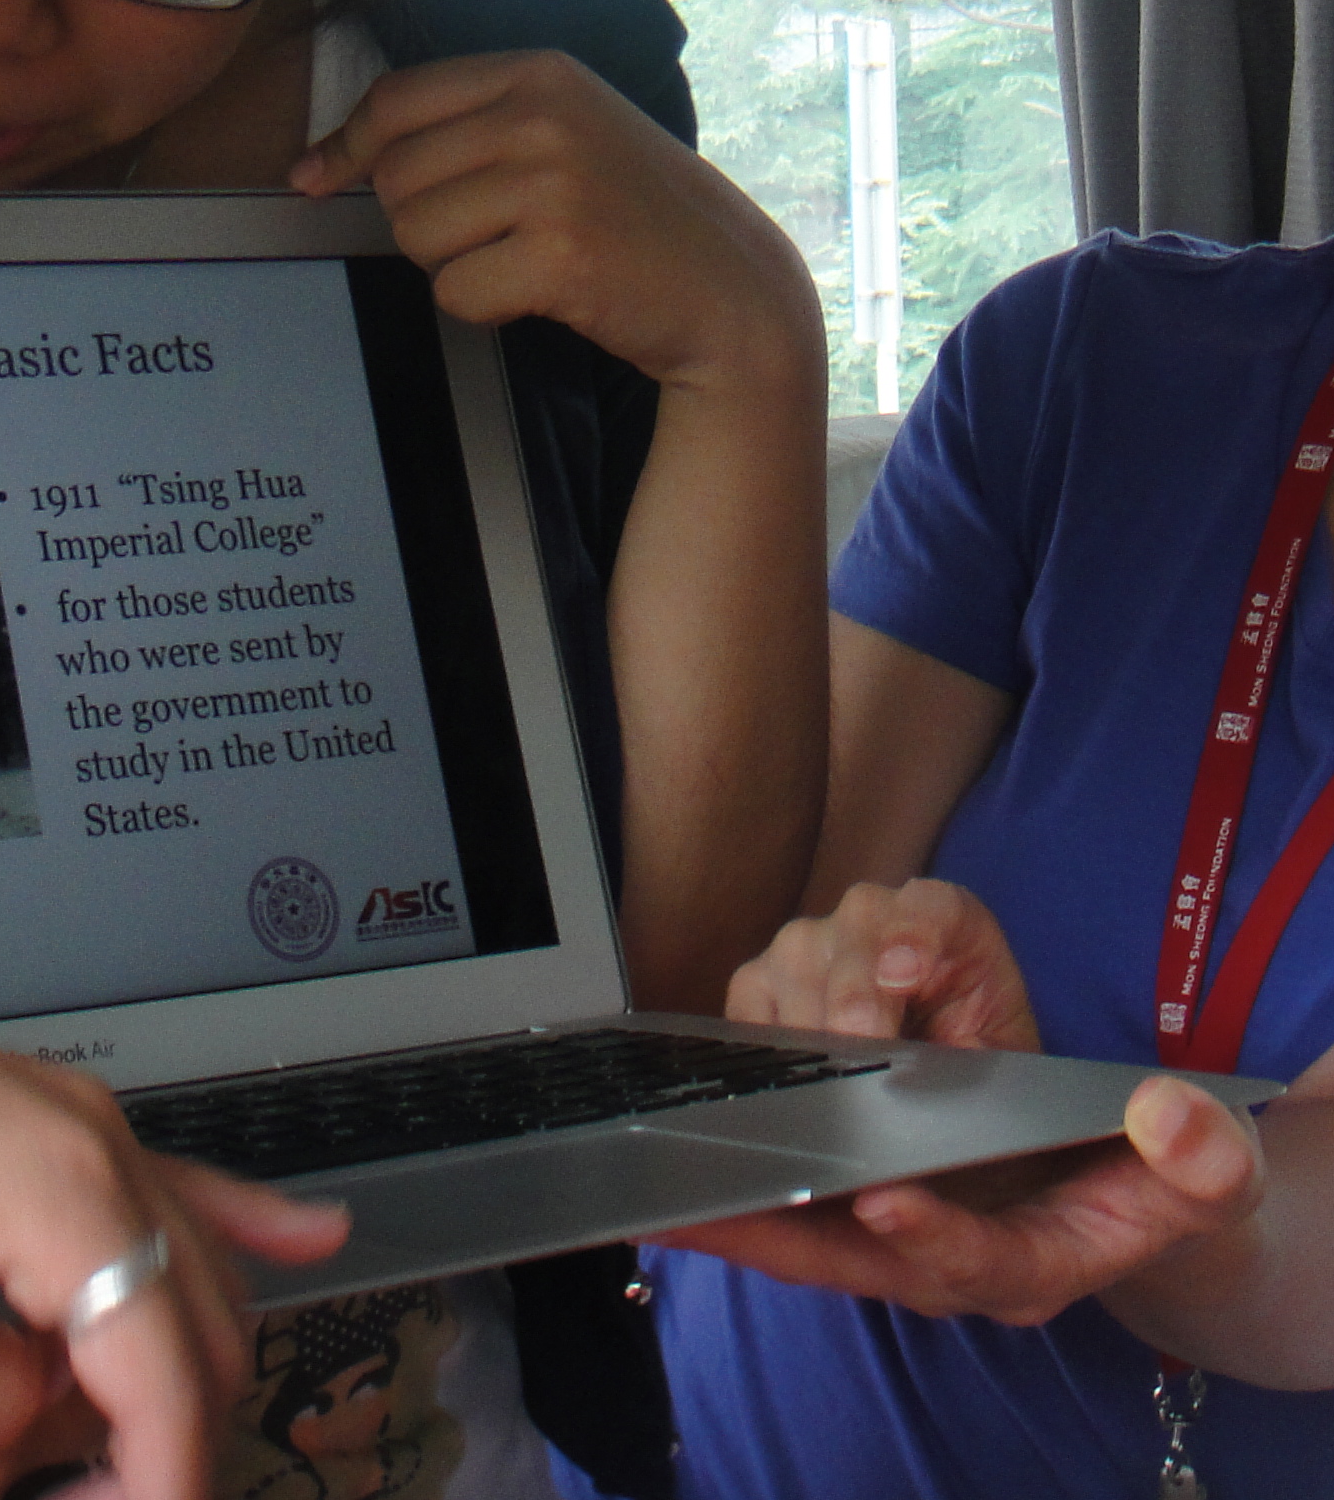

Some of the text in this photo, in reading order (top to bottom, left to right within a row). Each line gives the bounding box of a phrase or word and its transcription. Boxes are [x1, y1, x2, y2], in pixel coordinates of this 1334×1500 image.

[92, 332, 215, 375] Facts
[29, 483, 102, 517] 1911
[235, 468, 307, 501] Hua
[36, 521, 187, 568] Imperial
[57, 575, 356, 624] for those students
[56, 624, 346, 677] who were sent by
[65, 677, 373, 734] the government to
[75, 720, 397, 784] study in the United
[84, 801, 200, 837] States.
[92, 1039, 115, 1059] Air
